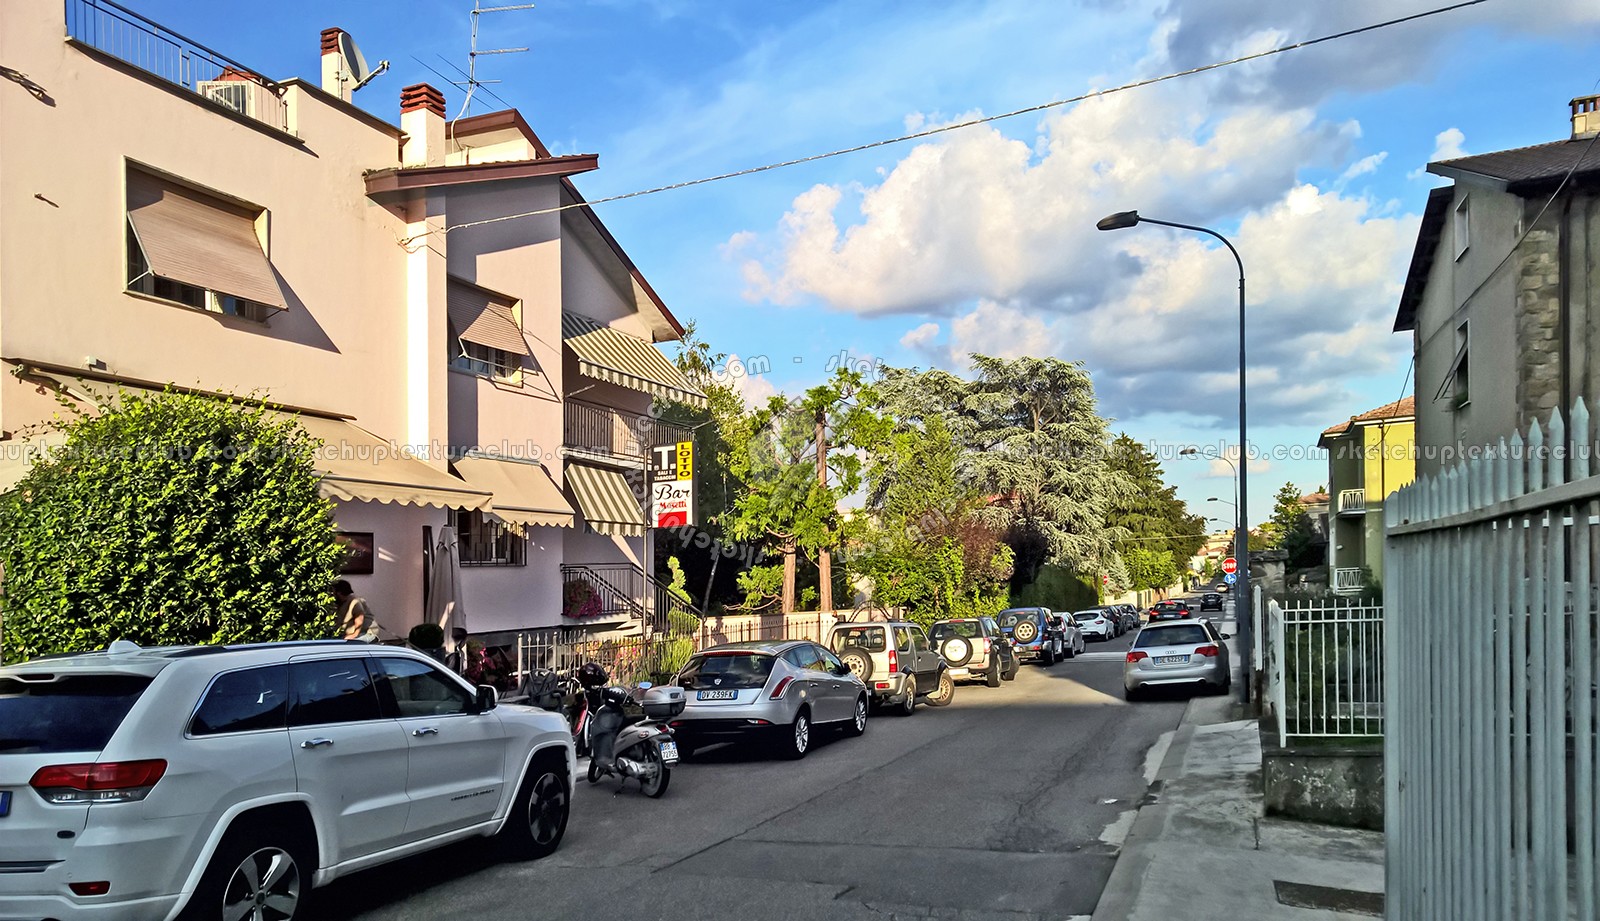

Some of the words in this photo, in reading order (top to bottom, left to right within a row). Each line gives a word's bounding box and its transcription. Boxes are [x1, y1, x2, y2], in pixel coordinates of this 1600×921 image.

[679, 444, 691, 477] LOTTO
[655, 484, 691, 500] Bar
[1223, 562, 1237, 570] STOP
